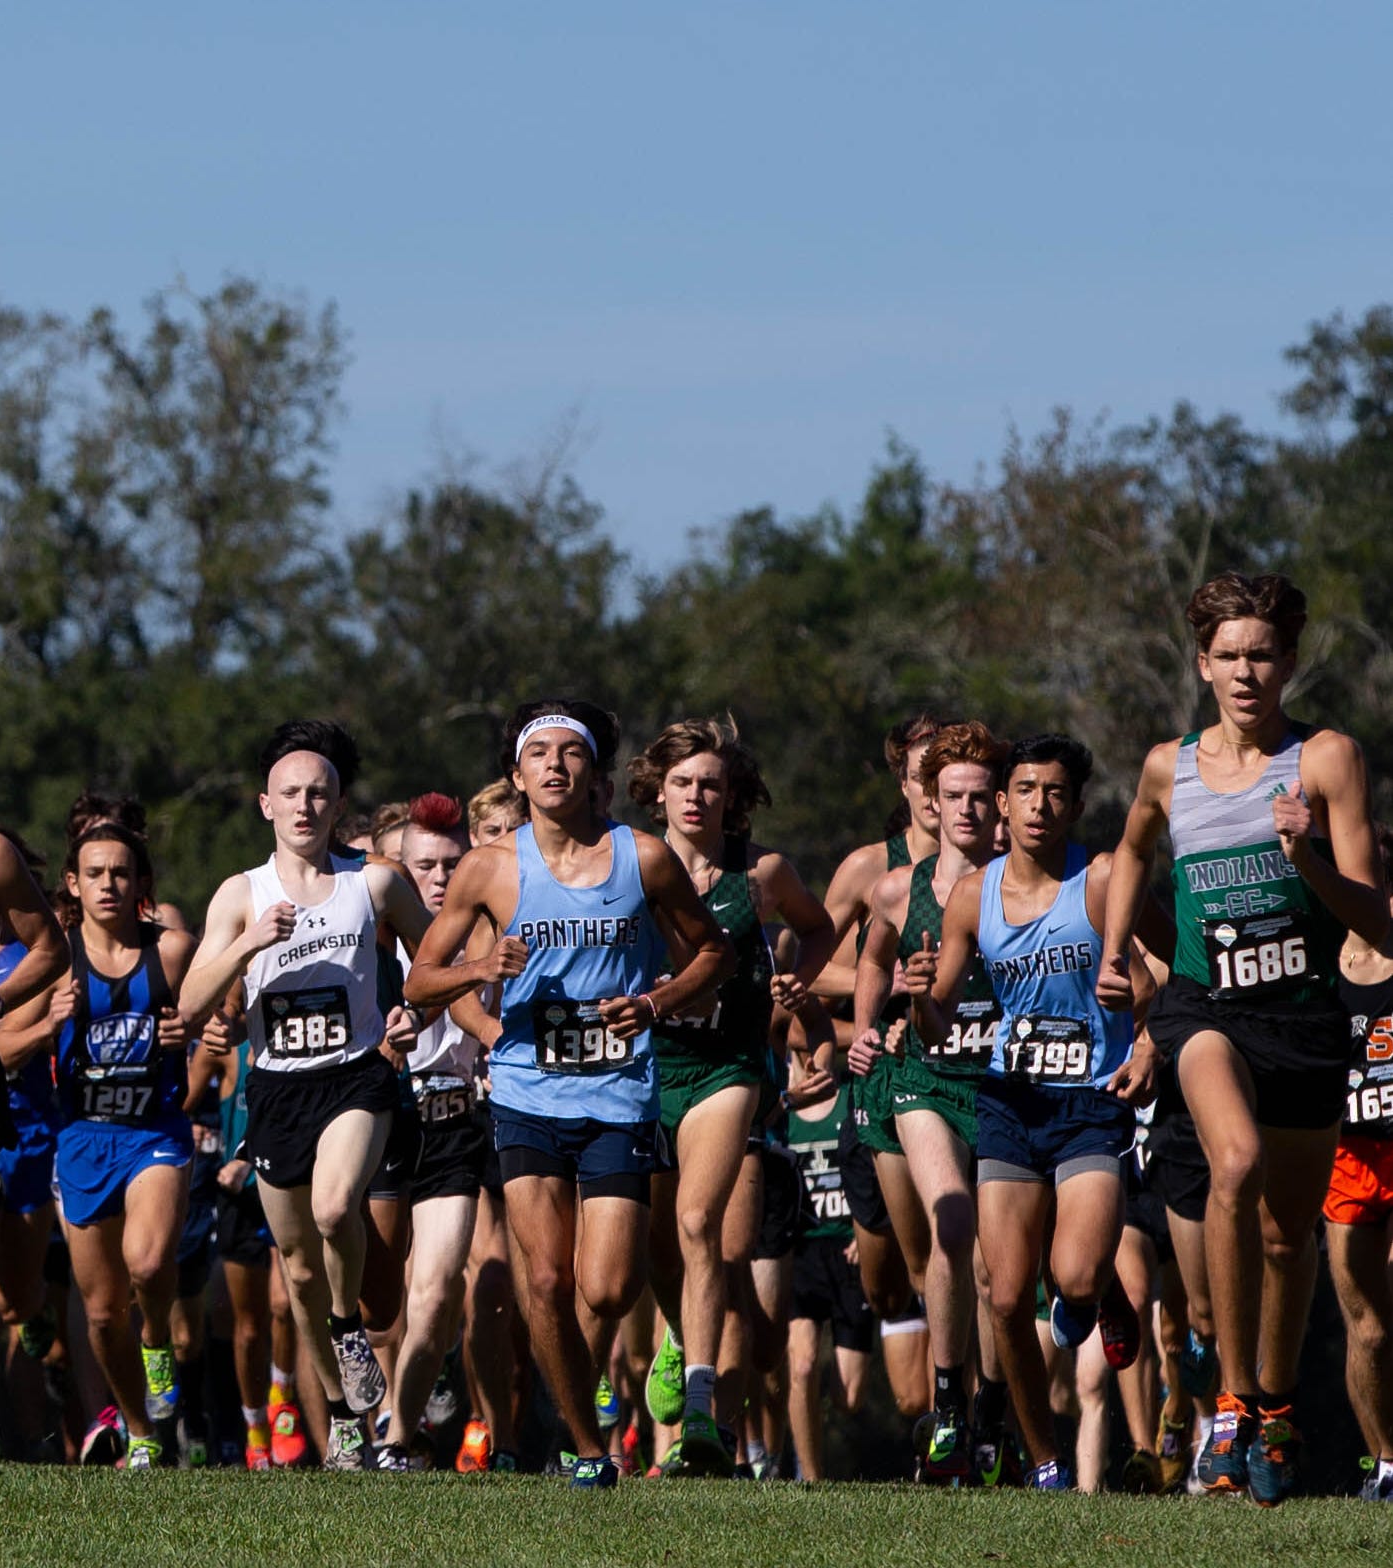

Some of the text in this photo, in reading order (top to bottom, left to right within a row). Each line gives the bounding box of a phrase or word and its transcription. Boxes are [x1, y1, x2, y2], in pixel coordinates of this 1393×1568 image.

[1184, 850, 1300, 894] INDIANS
[520, 916, 640, 949] PANTHERS
[277, 933, 365, 968] CREEKSIDE
[1217, 937, 1307, 989] 1686
[272, 1013, 347, 1051] 1383
[544, 1027, 627, 1064] 1398
[929, 1021, 1001, 1055] 344
[1005, 1042, 1088, 1076] 1399
[83, 1084, 154, 1116] 1297
